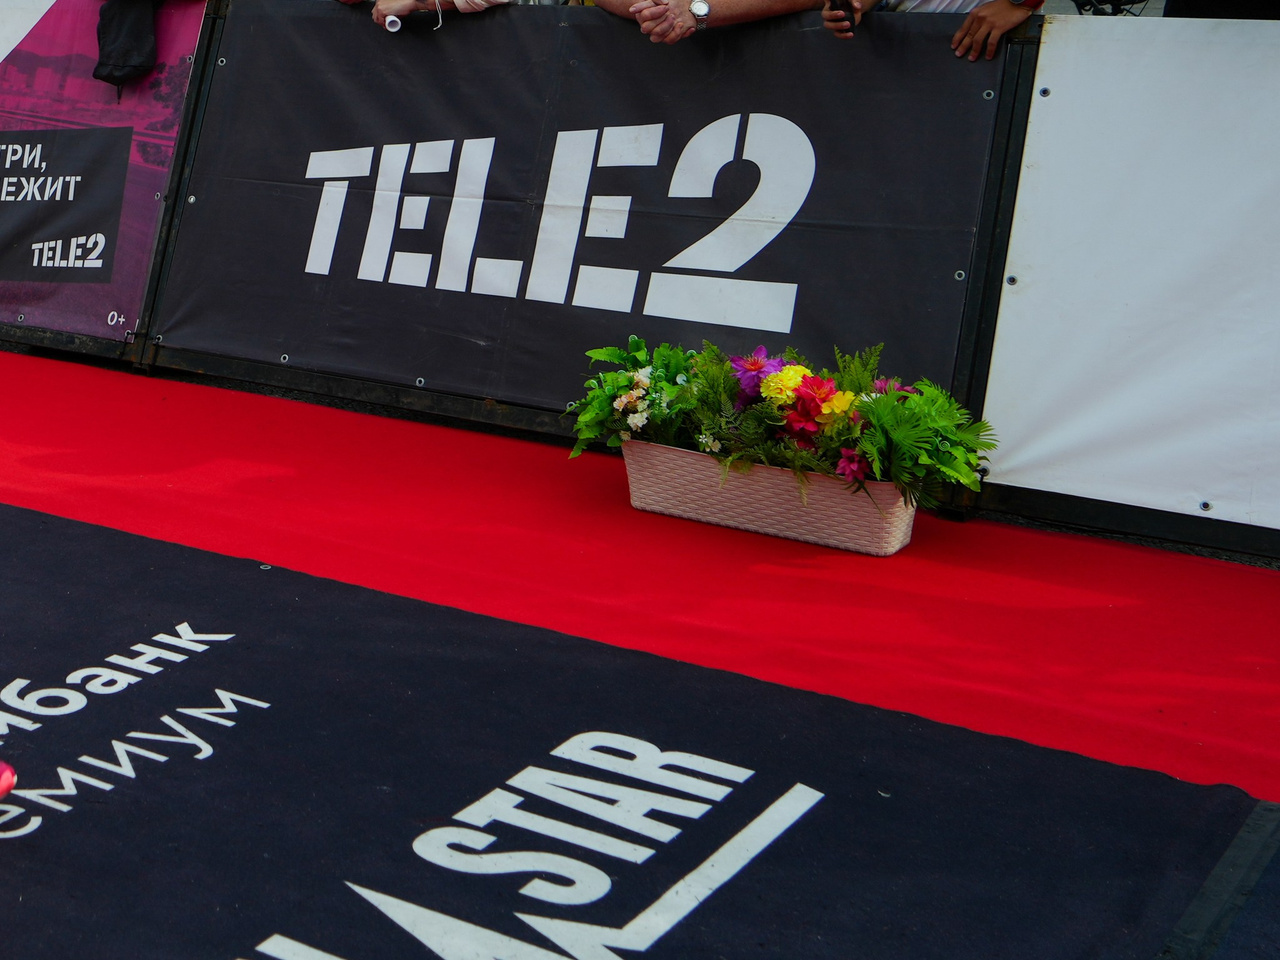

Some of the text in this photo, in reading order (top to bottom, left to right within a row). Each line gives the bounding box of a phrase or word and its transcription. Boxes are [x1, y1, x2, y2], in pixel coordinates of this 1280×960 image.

[31, 233, 106, 268] TELE2
[305, 113, 816, 334] TELE2
[107, 311, 126, 326] 0+
[412, 731, 755, 906] STAR
